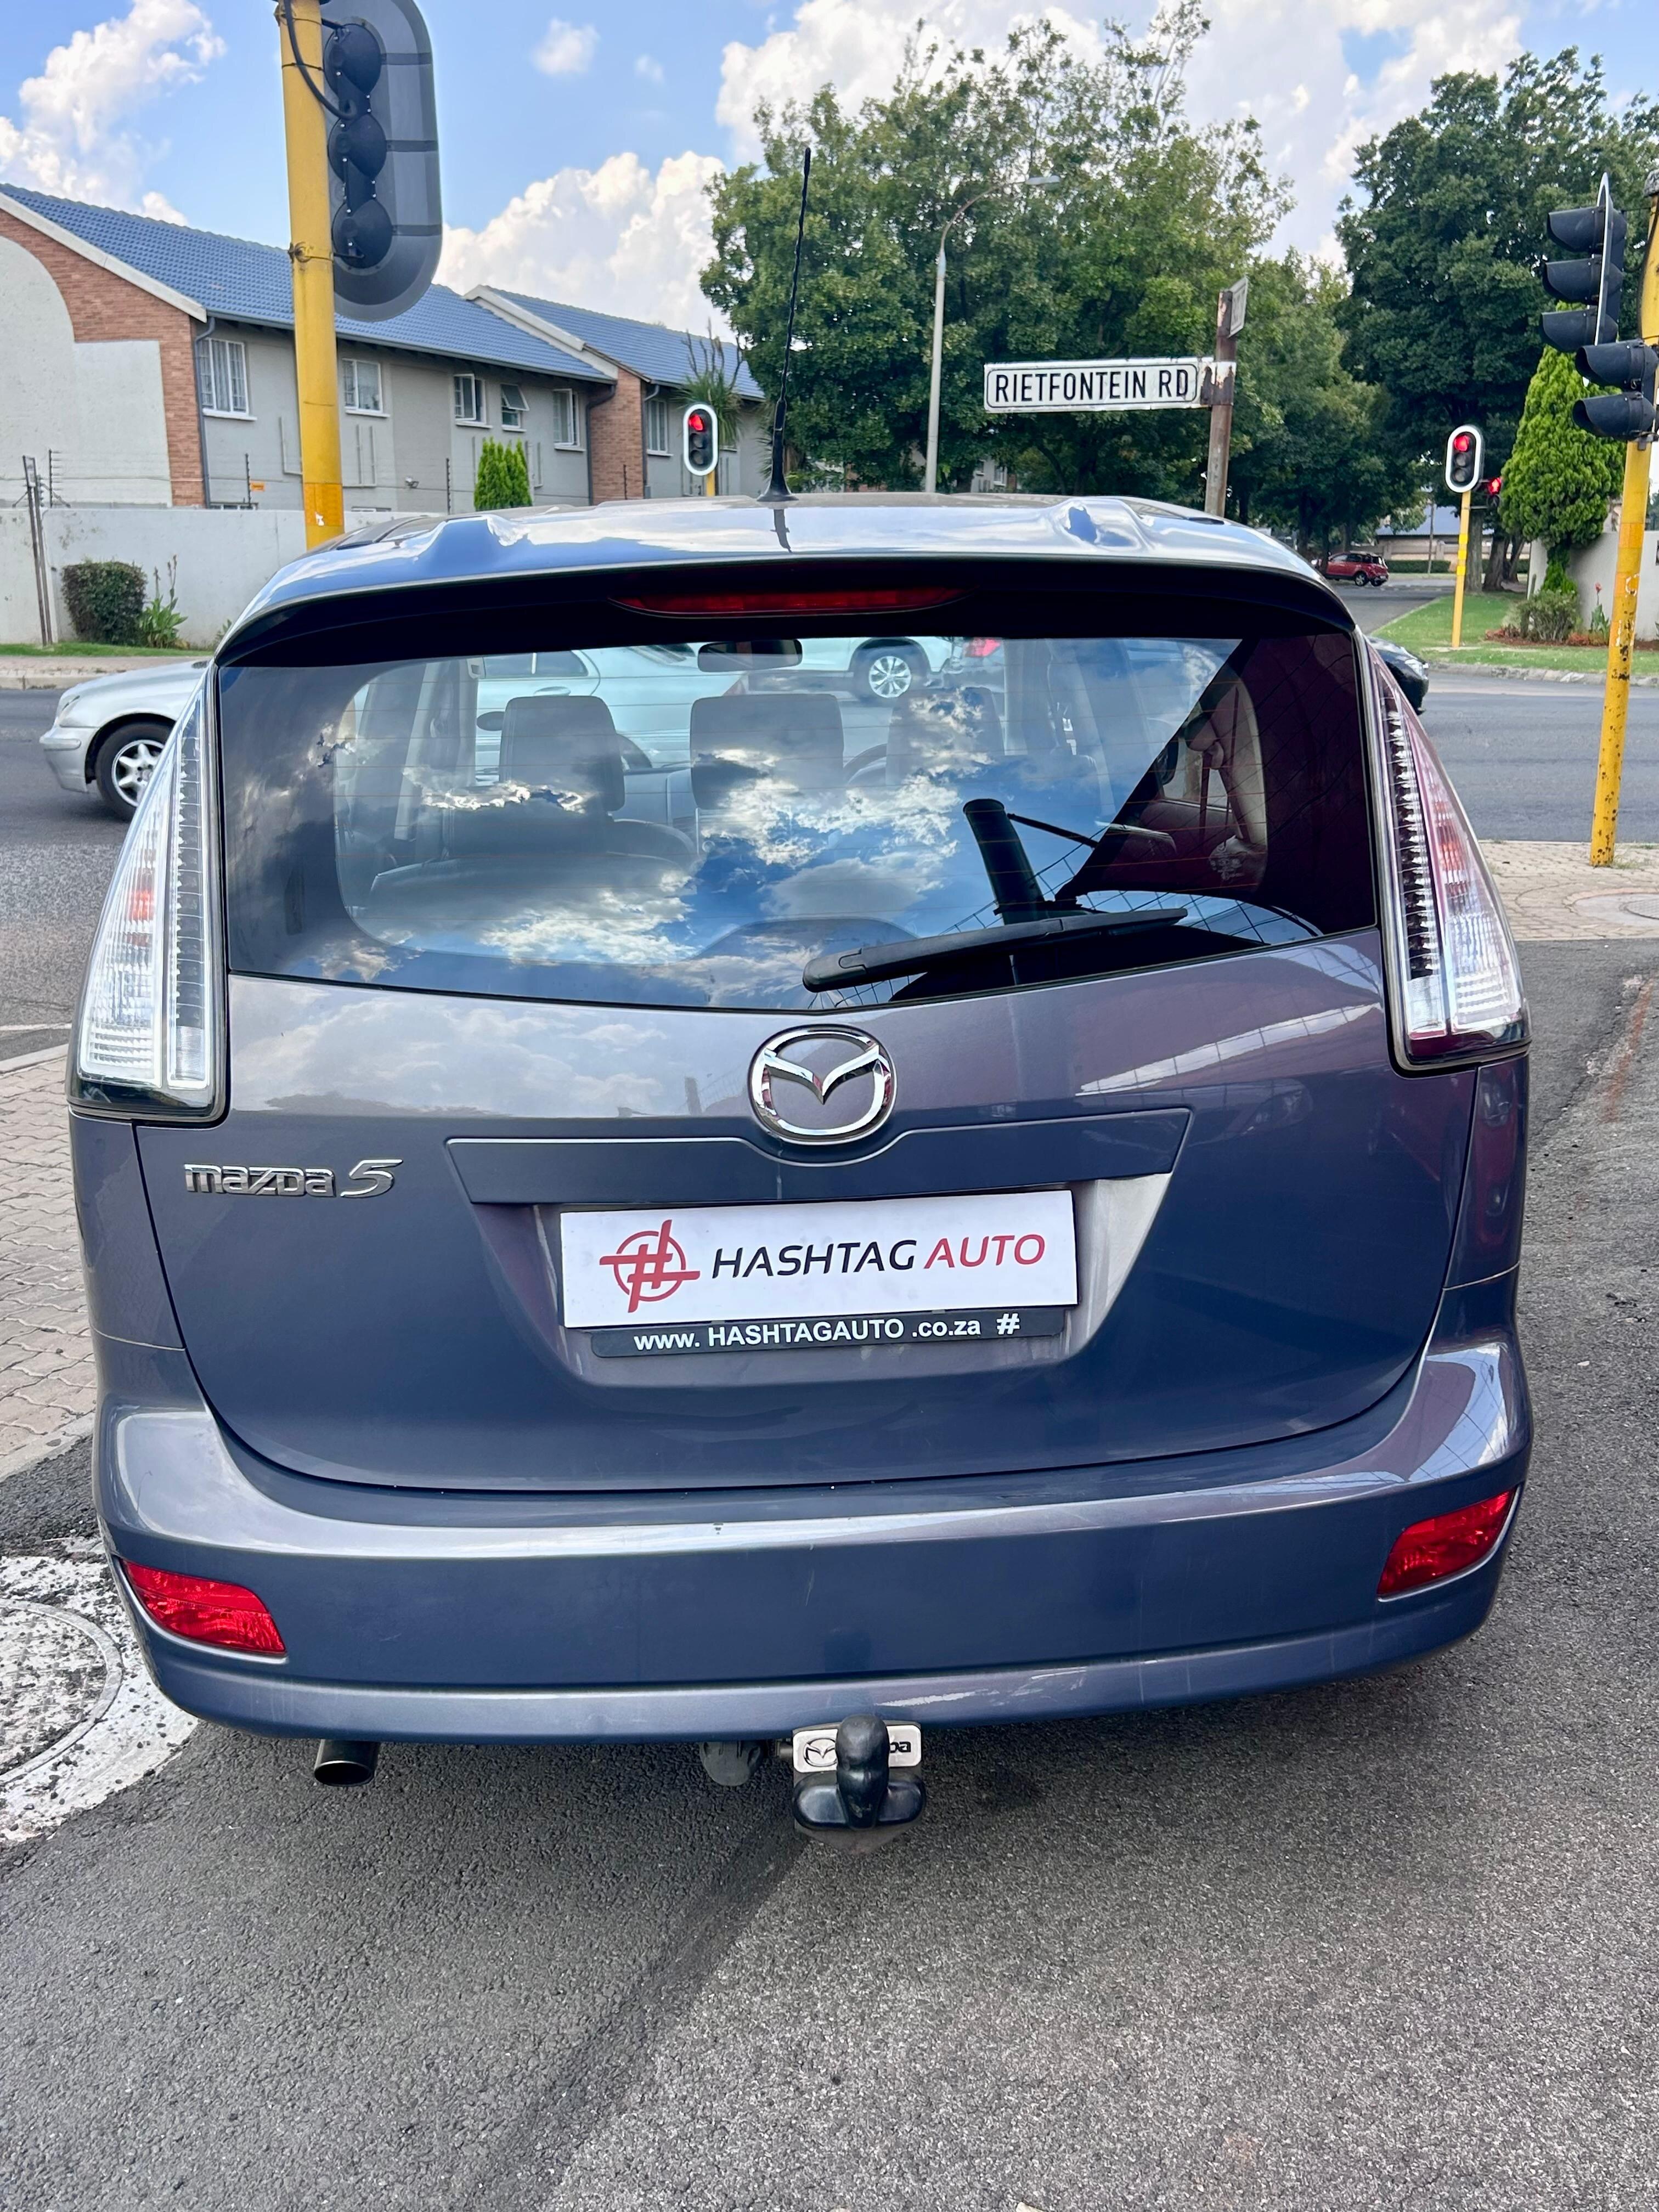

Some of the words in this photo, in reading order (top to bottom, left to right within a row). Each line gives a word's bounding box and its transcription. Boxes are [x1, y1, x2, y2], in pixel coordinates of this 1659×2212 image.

[995, 370, 1147, 403] RIETFONTEIN
[1158, 369, 1189, 398] RD
[340, 1159, 403, 1198] 5
[712, 1240, 917, 1279] HASHTAG
[924, 1234, 1045, 1269] AUTO
[634, 1333, 700, 1351] www.
[708, 1318, 904, 1346] HASHTAGAUTO
[912, 1319, 981, 1338] .co.za
